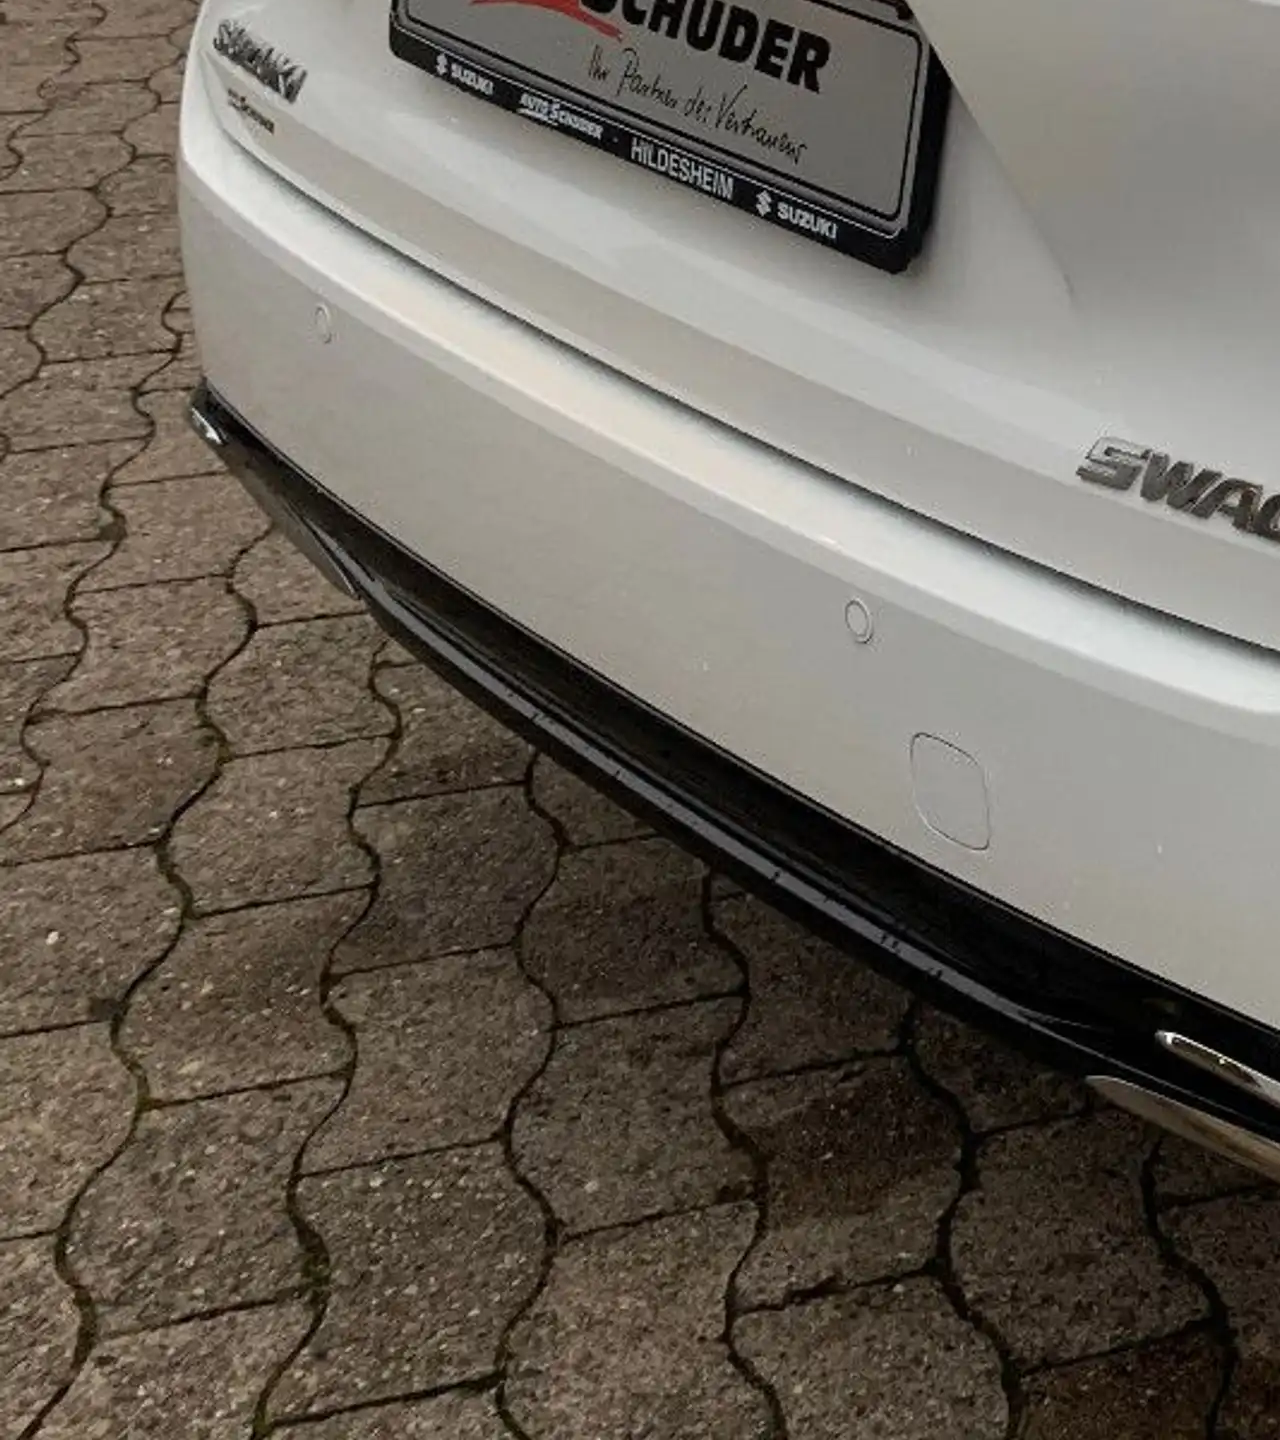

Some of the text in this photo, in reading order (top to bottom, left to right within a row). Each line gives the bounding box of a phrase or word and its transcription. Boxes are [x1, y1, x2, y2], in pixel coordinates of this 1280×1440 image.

[451, 62, 494, 96] SUZUKI
[631, 137, 734, 200] HILDESHEIM
[777, 201, 839, 240] SUZUKI
